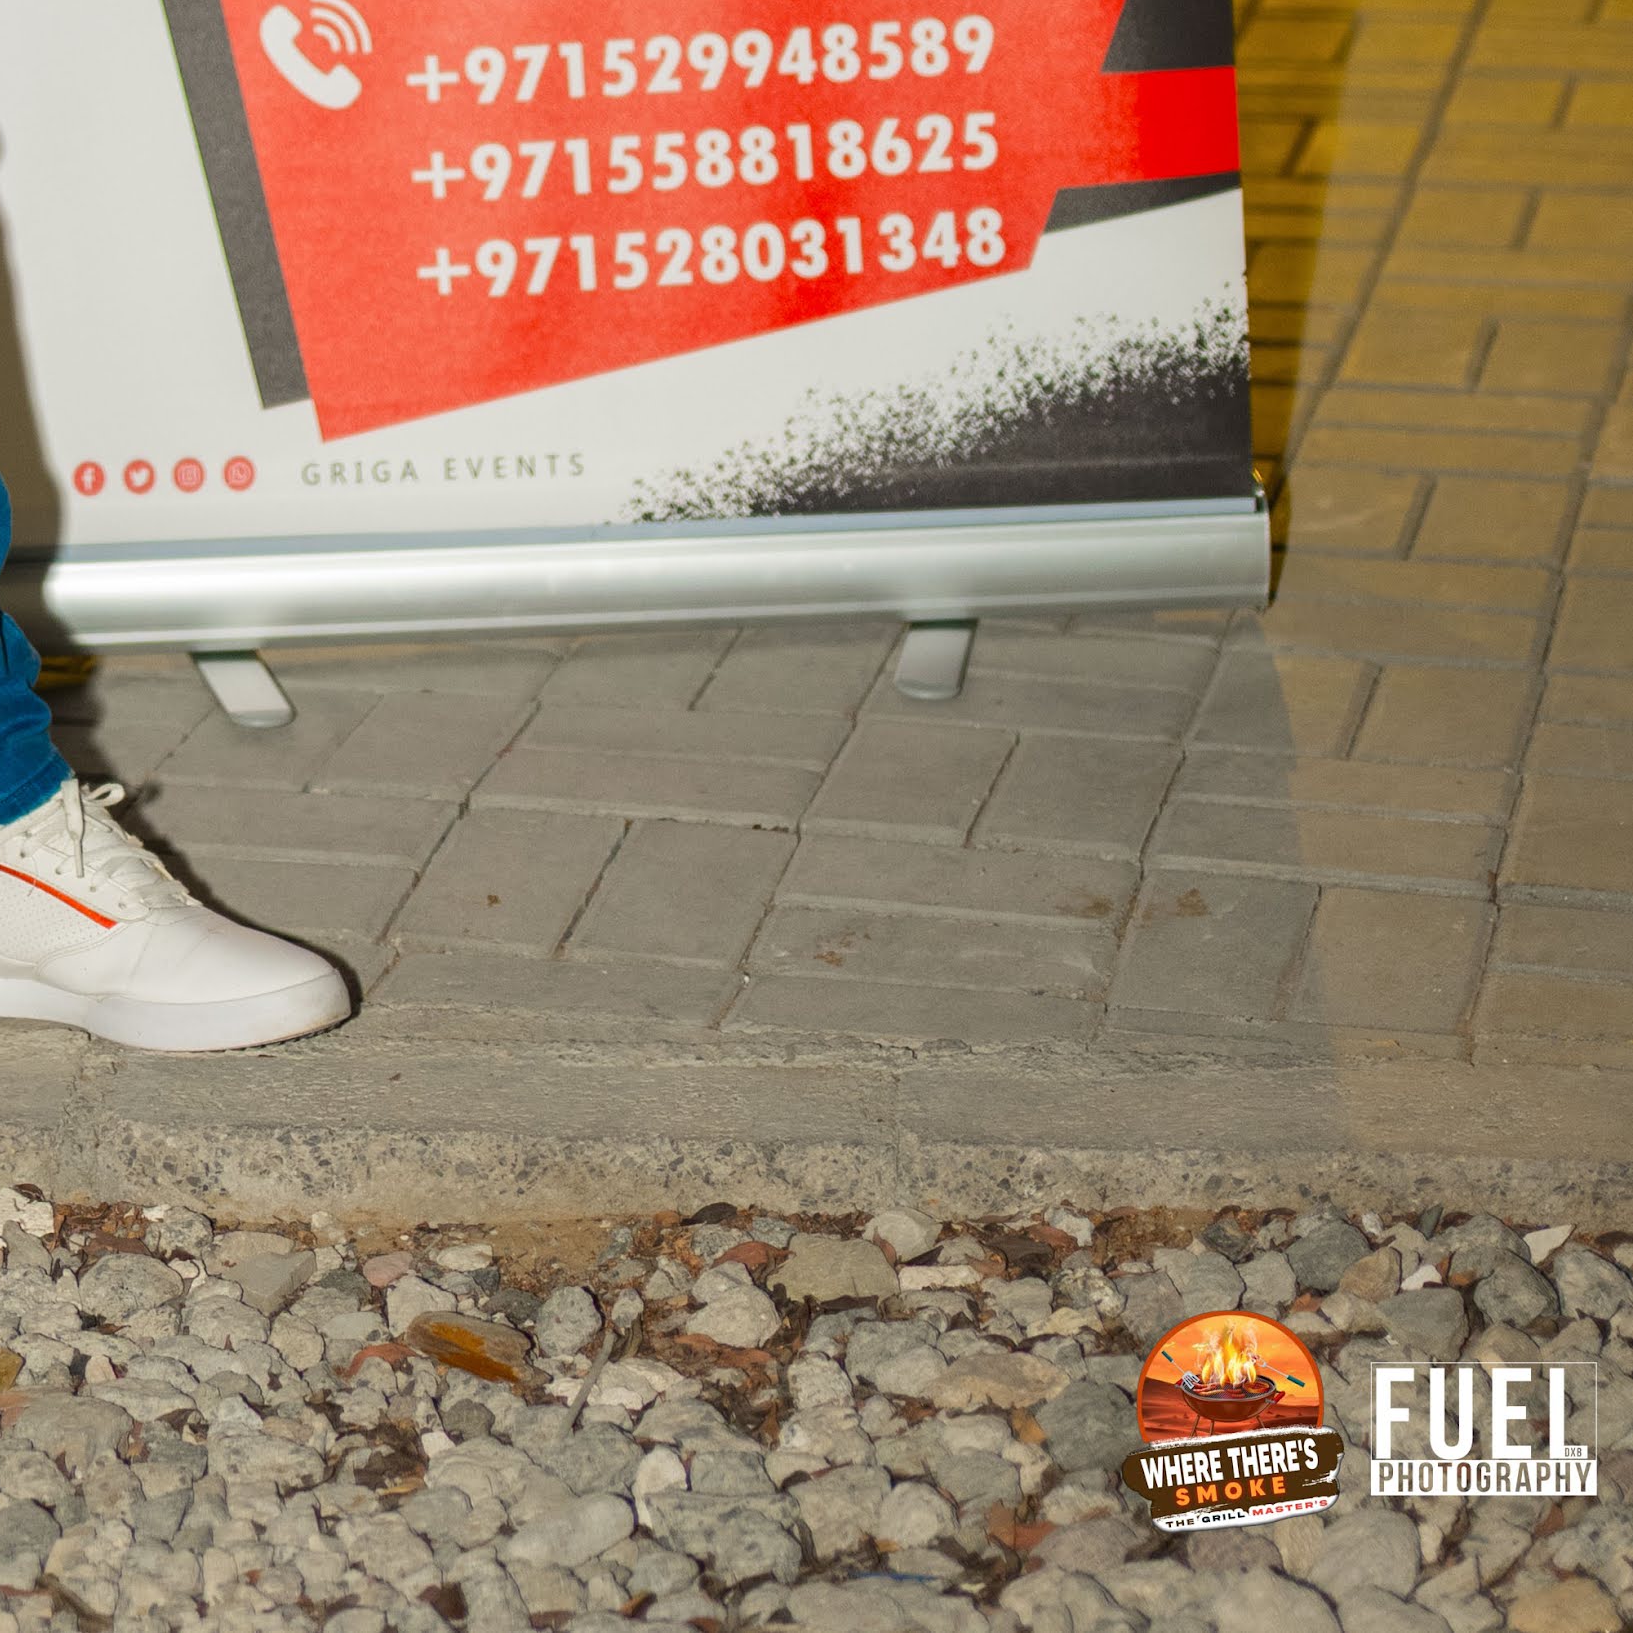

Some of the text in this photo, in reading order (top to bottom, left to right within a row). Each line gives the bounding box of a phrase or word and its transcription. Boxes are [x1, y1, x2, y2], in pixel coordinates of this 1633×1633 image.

[406, 14, 996, 106] +971529948589
[411, 111, 999, 202] +971558818625
[417, 207, 1007, 298] +971528031348
[301, 452, 586, 487] GRIGA EVENTS
